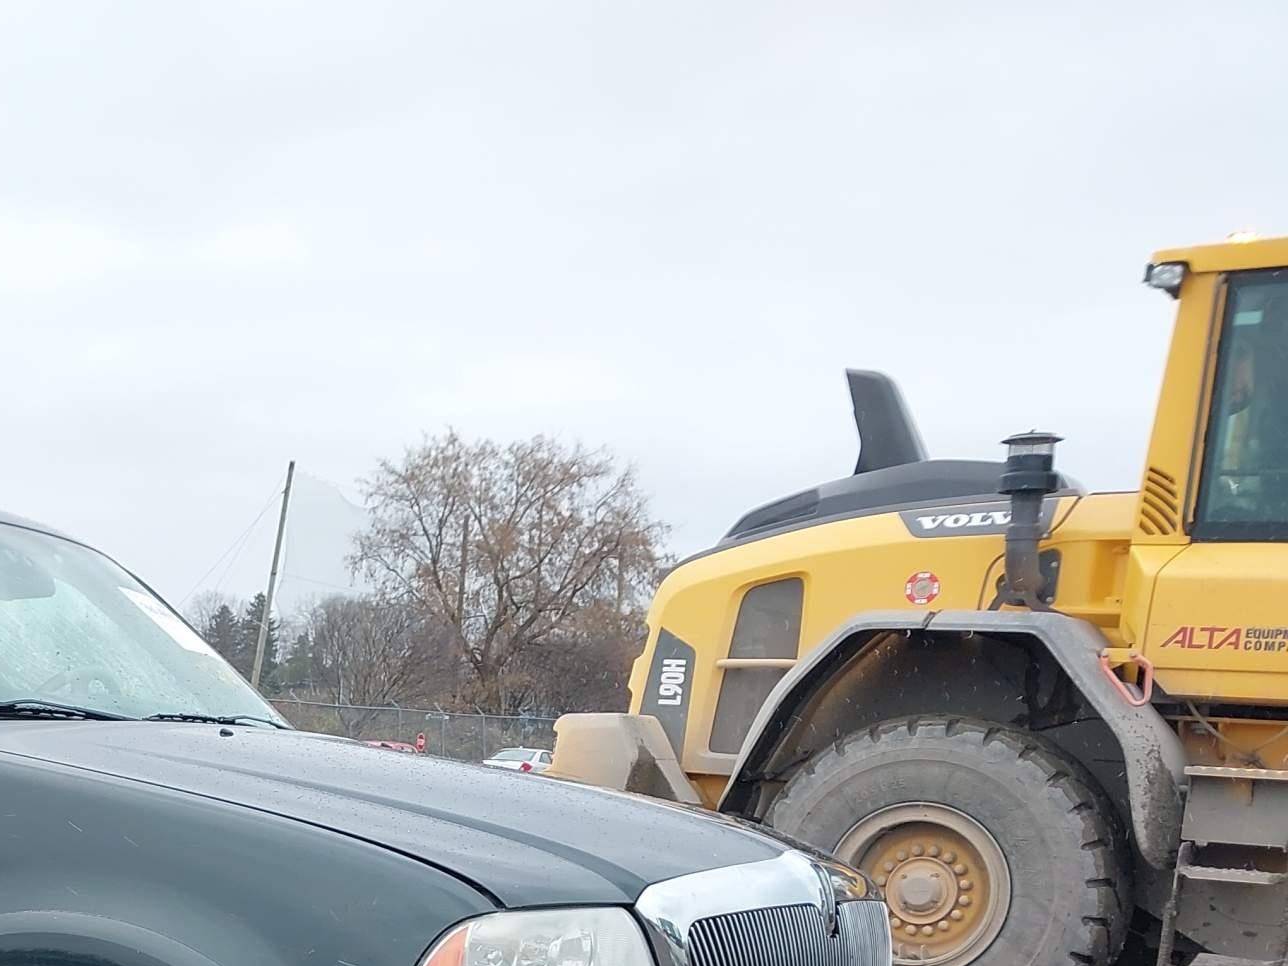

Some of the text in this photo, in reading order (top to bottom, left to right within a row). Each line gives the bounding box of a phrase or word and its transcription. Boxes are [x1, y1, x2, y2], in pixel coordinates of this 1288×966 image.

[915, 511, 1013, 530] VOLV
[1160, 626, 1242, 650] ALTA
[1243, 640, 1288, 652] COMP
[657, 659, 687, 706] L90H
